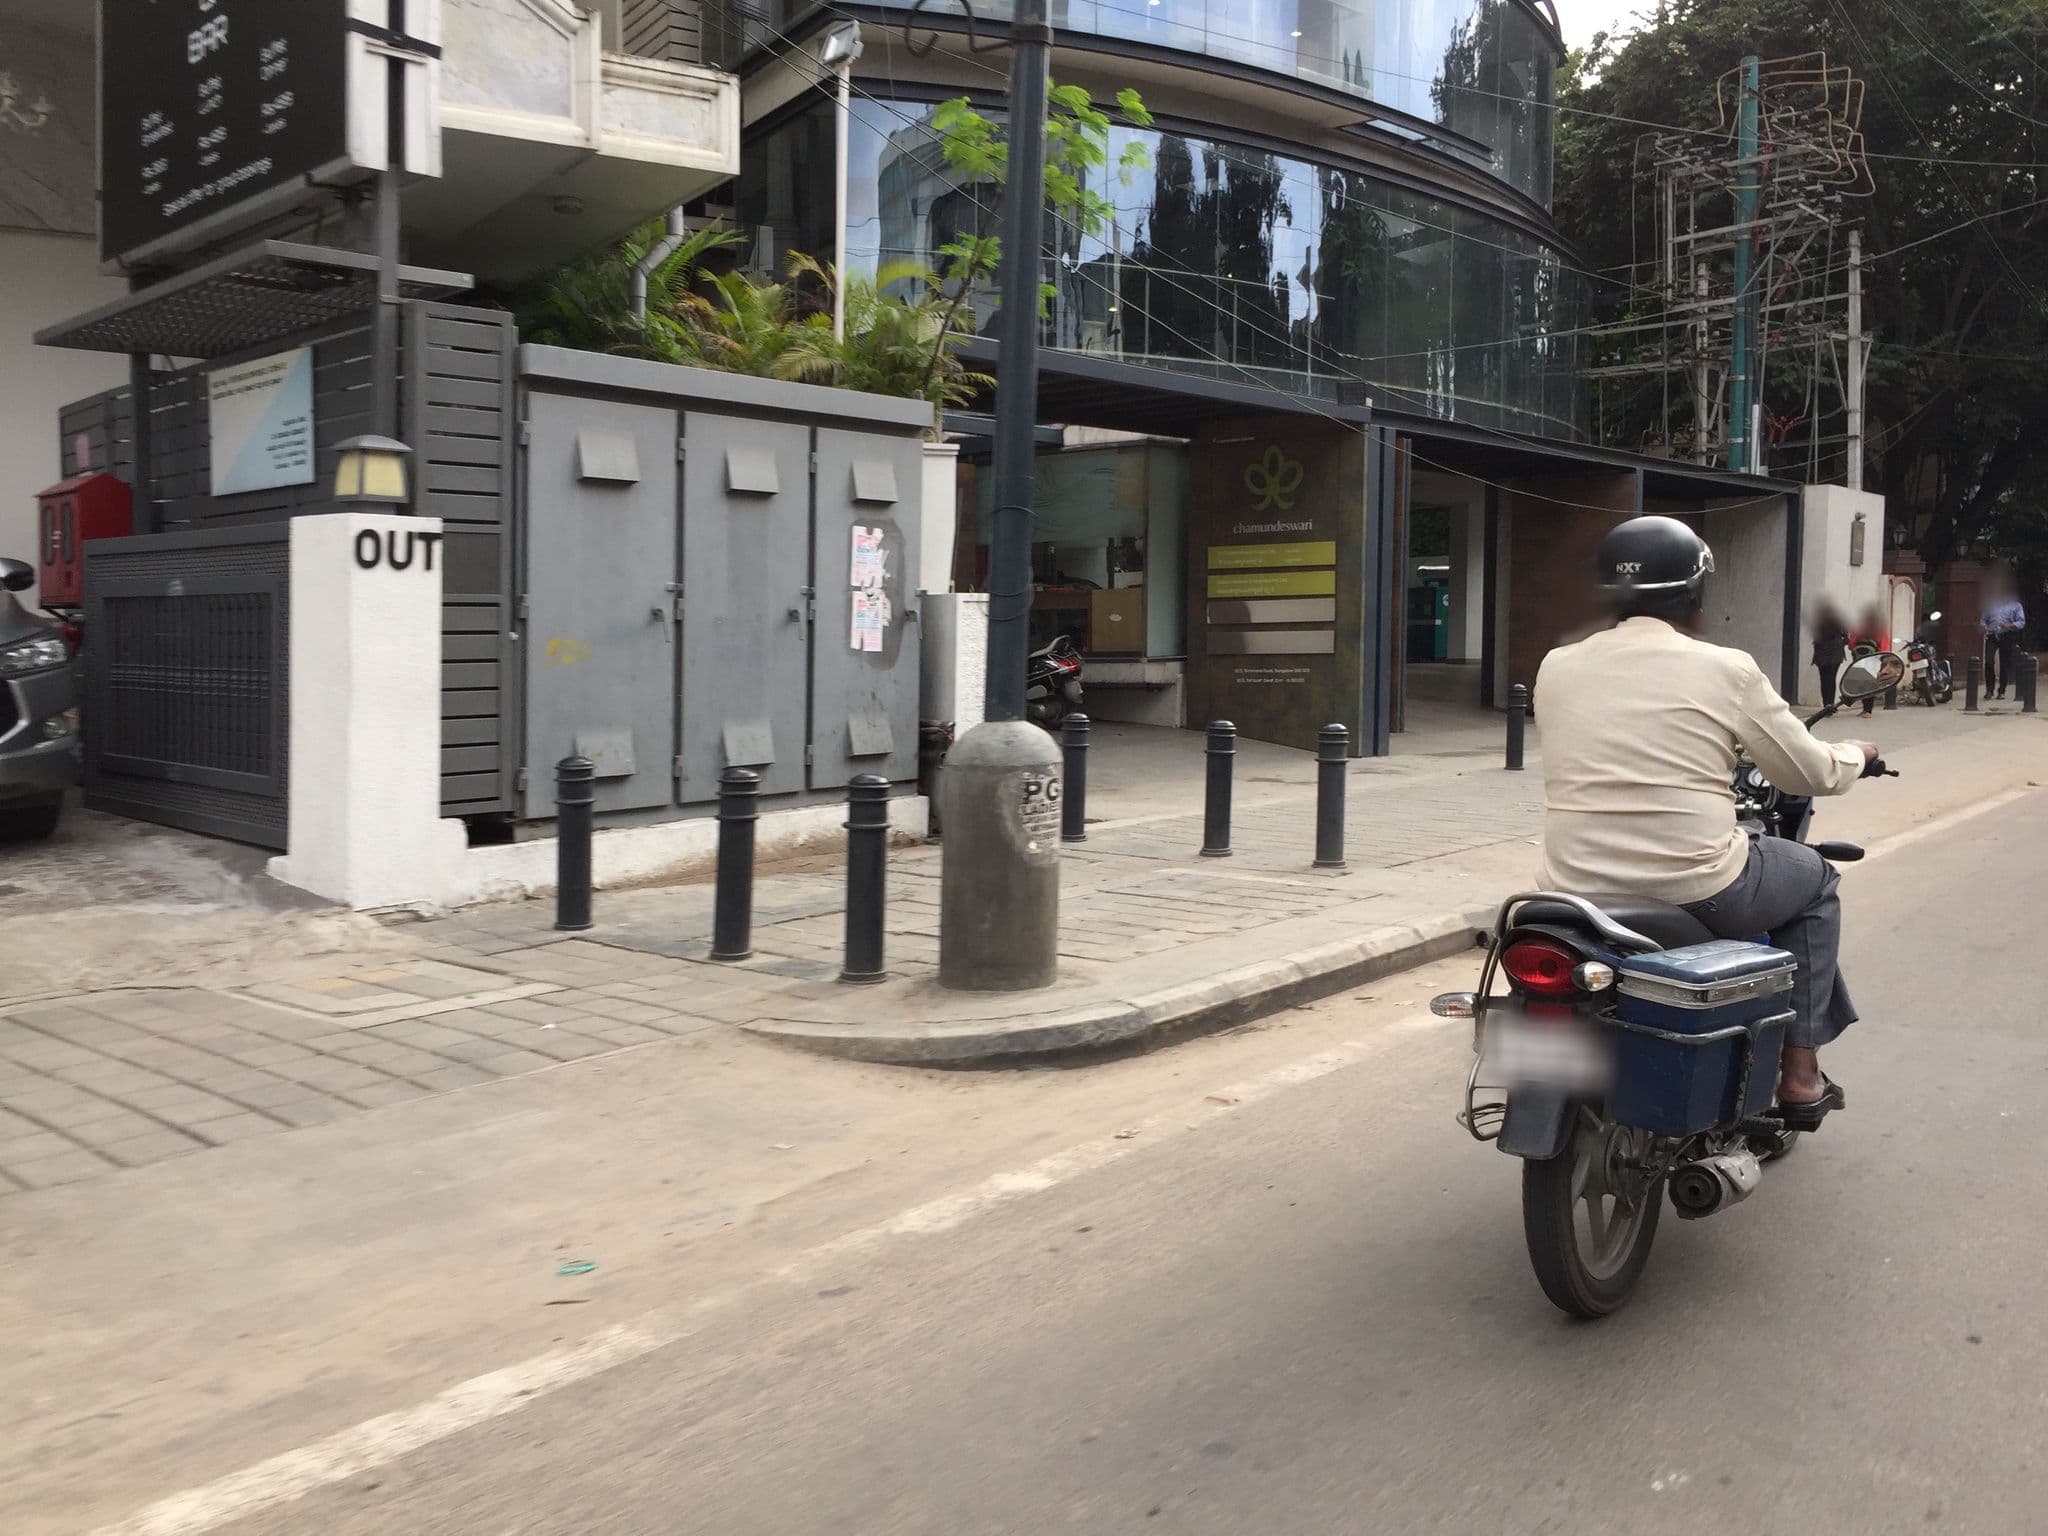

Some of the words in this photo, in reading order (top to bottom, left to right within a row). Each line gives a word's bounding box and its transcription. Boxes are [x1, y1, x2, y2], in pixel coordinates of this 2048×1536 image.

[1232, 519, 1313, 535] chamundeswari
[355, 528, 443, 571] OUT
[1616, 562, 1642, 574] NXT
